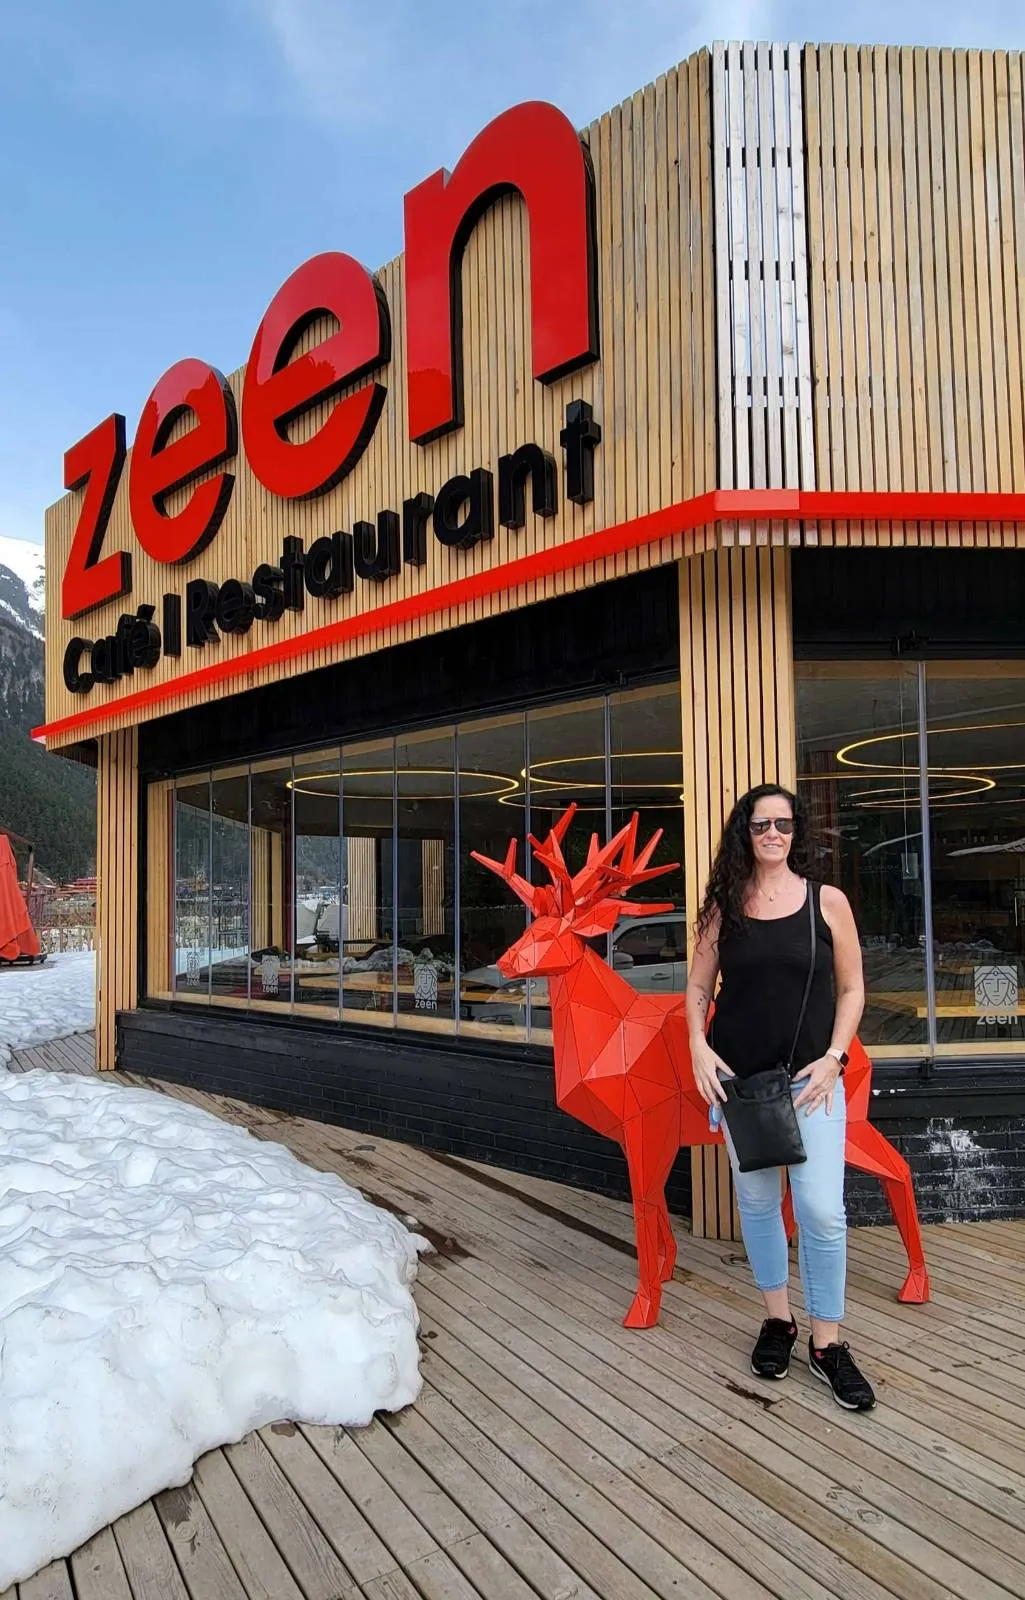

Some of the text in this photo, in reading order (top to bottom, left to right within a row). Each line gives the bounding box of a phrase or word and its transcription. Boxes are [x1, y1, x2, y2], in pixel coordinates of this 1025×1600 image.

[62, 101, 599, 621] zeen
[63, 603, 161, 693] Café
[186, 399, 601, 648] Restaurant
[415, 999, 437, 1010] zeen
[976, 1014, 1018, 1025] zeen
